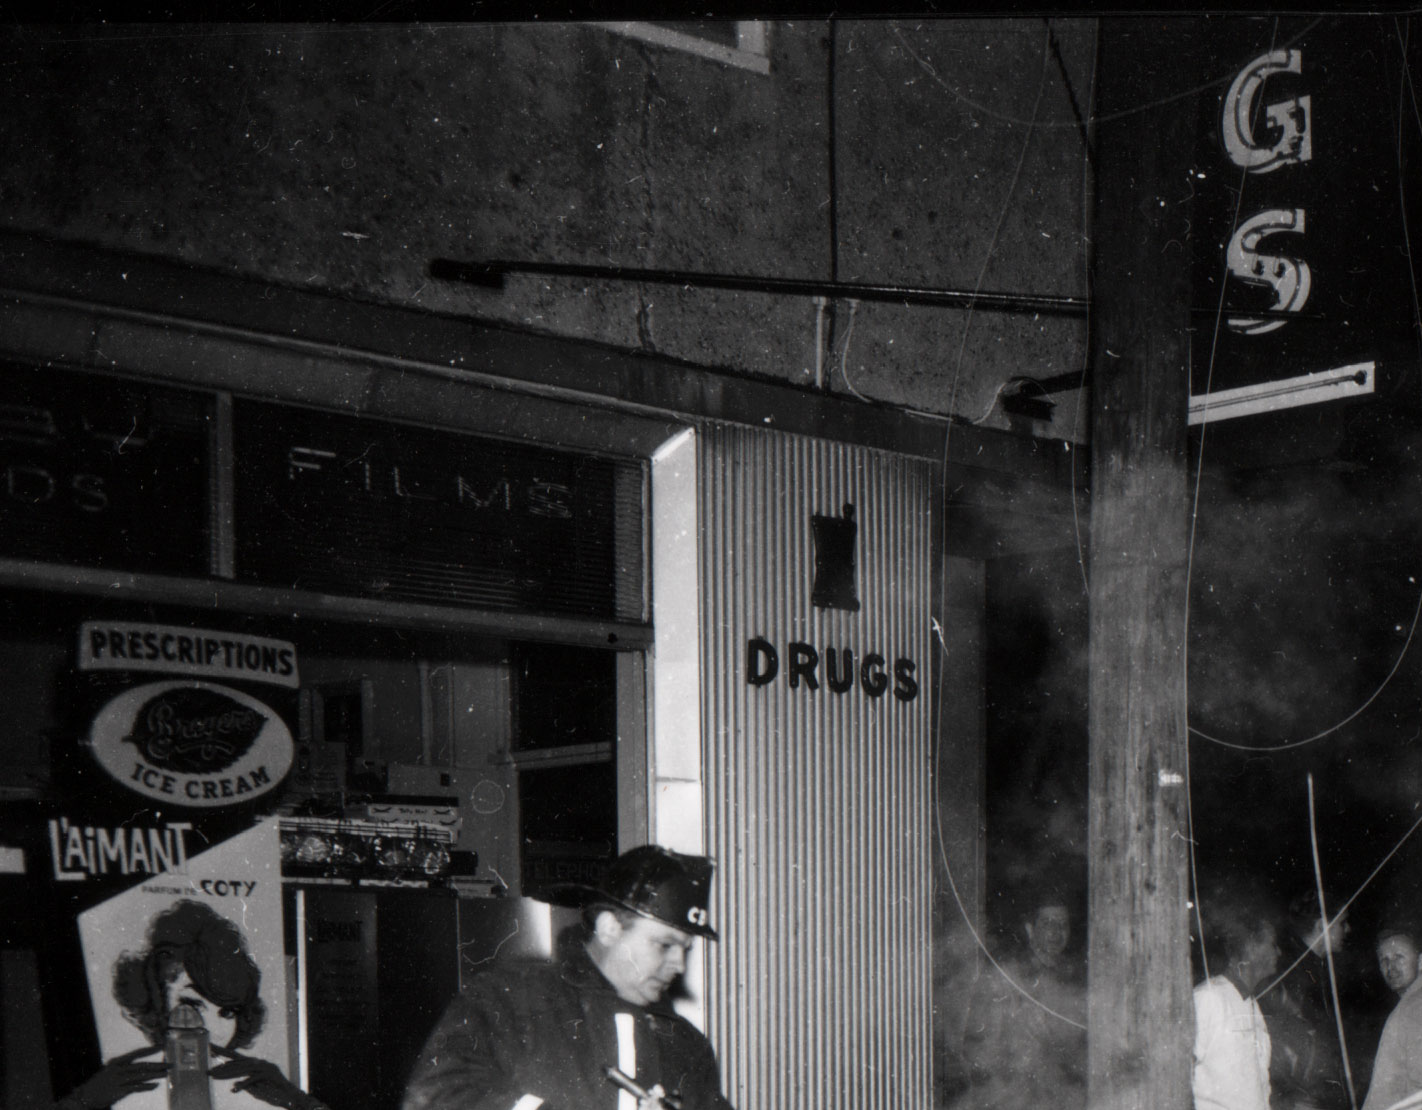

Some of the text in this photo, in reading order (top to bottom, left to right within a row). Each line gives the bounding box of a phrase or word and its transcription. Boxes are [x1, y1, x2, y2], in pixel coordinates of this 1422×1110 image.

[288, 446, 573, 519] FILMS
[89, 629, 294, 677] PRESCRIPTIONS
[747, 636, 918, 702] DRUGS
[131, 763, 271, 799] ICE CREAM
[200, 879, 257, 897] COTY
